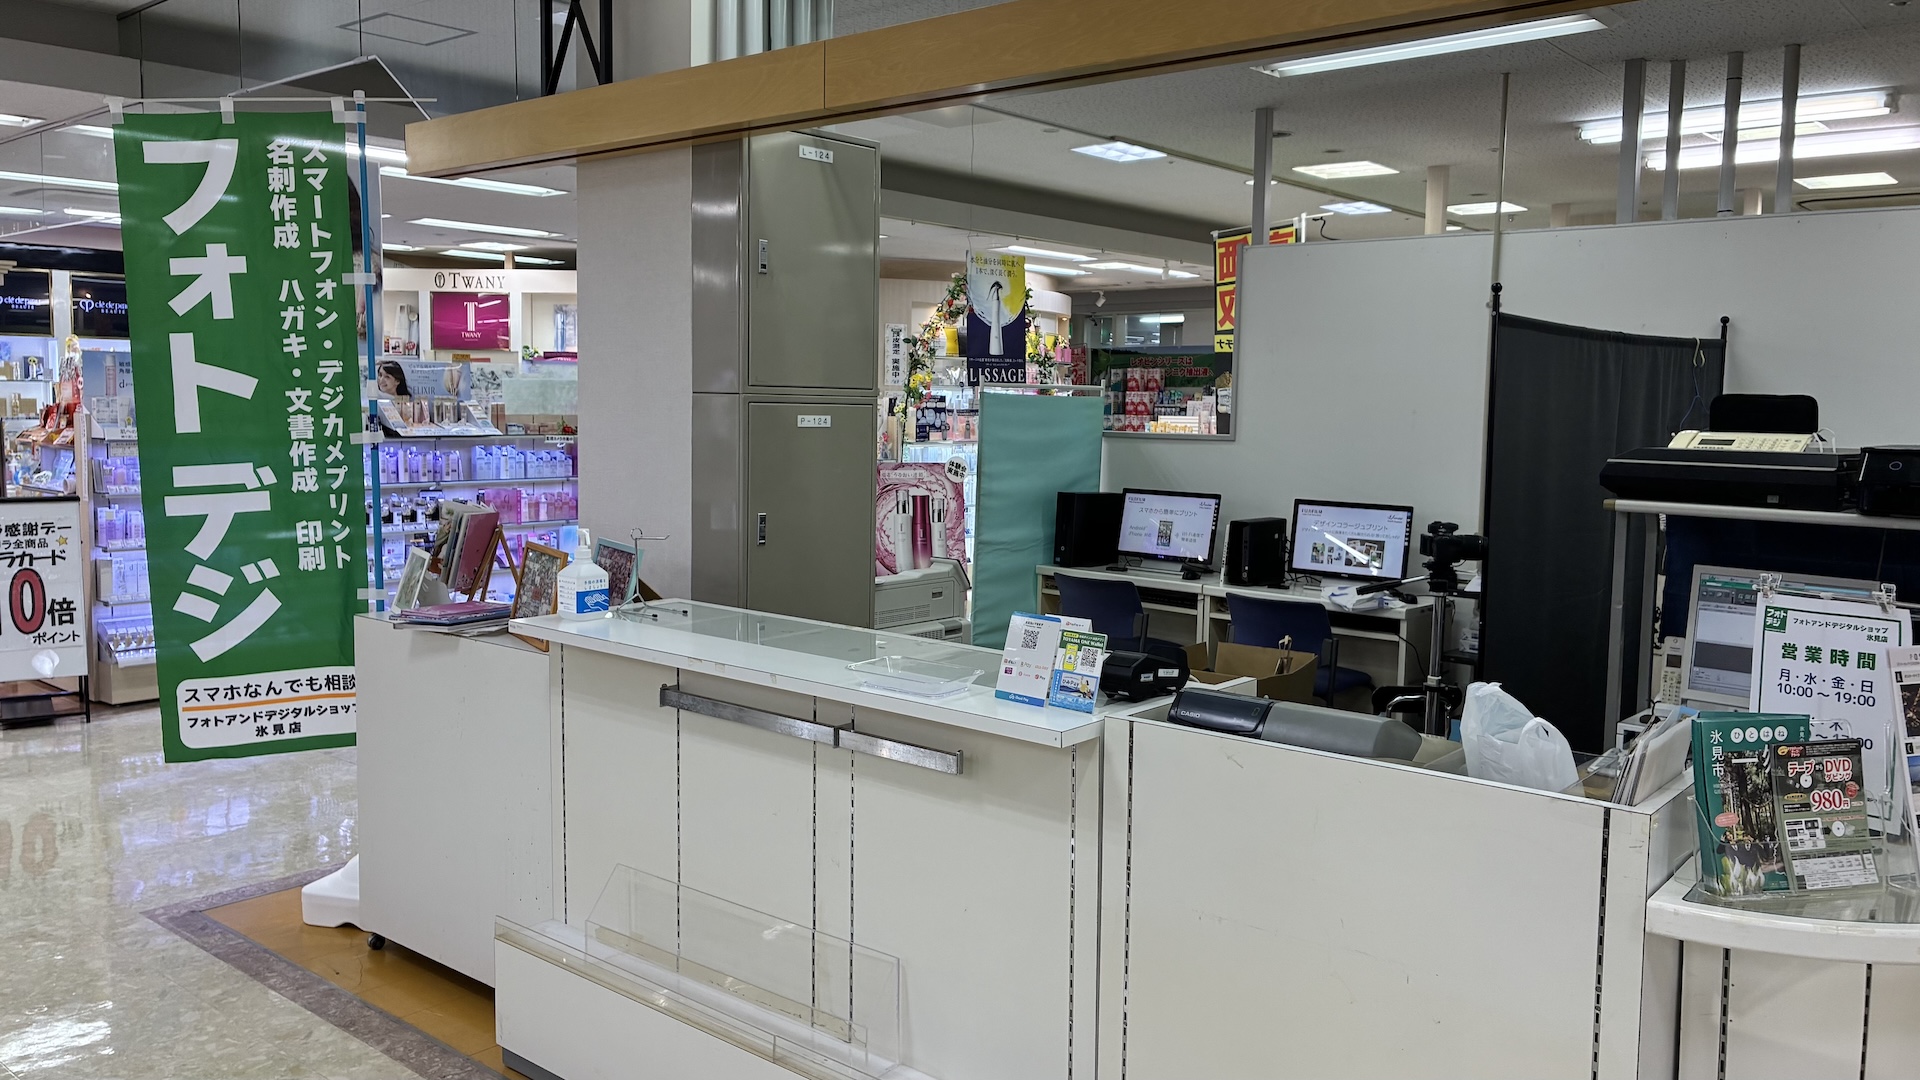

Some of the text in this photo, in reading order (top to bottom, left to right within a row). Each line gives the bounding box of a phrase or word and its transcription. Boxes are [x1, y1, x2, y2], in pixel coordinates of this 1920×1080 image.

[802, 148, 829, 160] L-124
[449, 272, 505, 289] TWANY
[461, 331, 482, 339] TWANY
[266, 138, 327, 571] 名刺作成 ハガキ・文書作成 印刷
[302, 139, 351, 569] スマートフォン・デジカメプリント
[970, 367, 1025, 383] LISSAGE
[142, 138, 282, 663] フォトデジ
[801, 417, 828, 426] P-124
[1766, 608, 1786, 618] フォト
[1766, 618, 1781, 627] デジ
[1793, 617, 1889, 633] フォトアンドデジタルショップ
[33, 630, 80, 644] ポイント
[1781, 642, 1876, 670] 営業時間
[184, 674, 357, 703] スマホなんでも相談
[1779, 668, 1873, 693] 月・水・金・日
[1180, 710, 1201, 718] CASIO
[255, 721, 302, 738] 氷見店
[1709, 729, 1724, 777] 氷見市
[1825, 772, 1852, 782] ダビング
[1810, 789, 1851, 812] 980円
